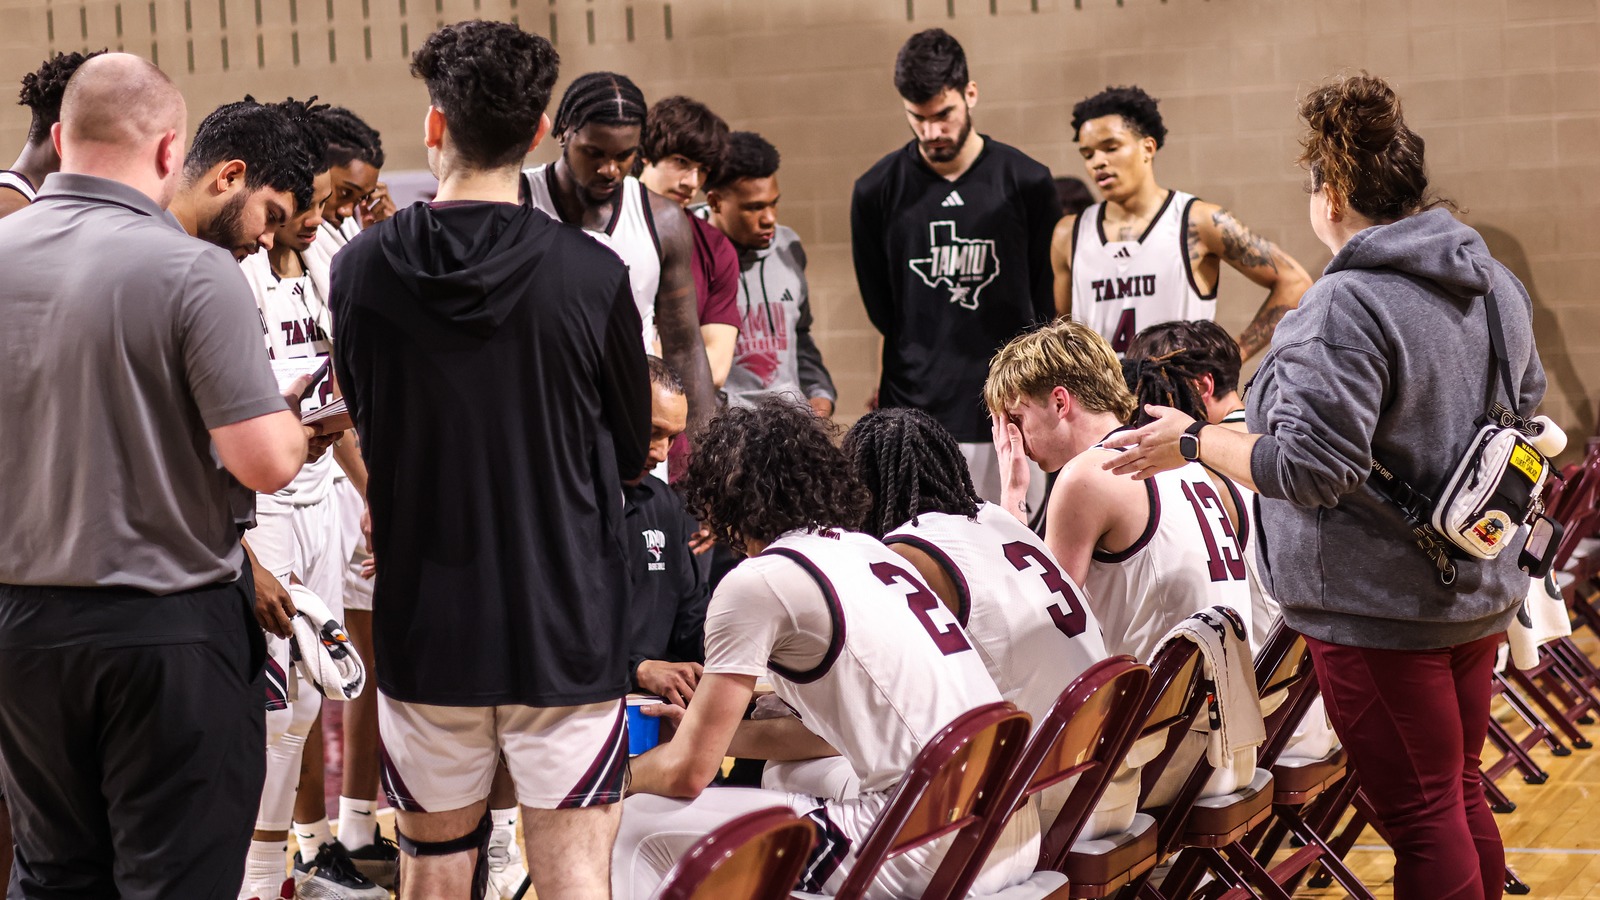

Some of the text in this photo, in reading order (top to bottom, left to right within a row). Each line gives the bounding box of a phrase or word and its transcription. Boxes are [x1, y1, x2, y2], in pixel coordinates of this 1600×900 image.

[930, 244, 987, 277] TAMIU
[1091, 274, 1156, 302] TAMIU
[1111, 307, 1136, 354] 4
[1380, 468, 1394, 481] DIE?
[1181, 479, 1246, 582] 13
[869, 561, 972, 656] 2
[1002, 540, 1087, 638] 3
